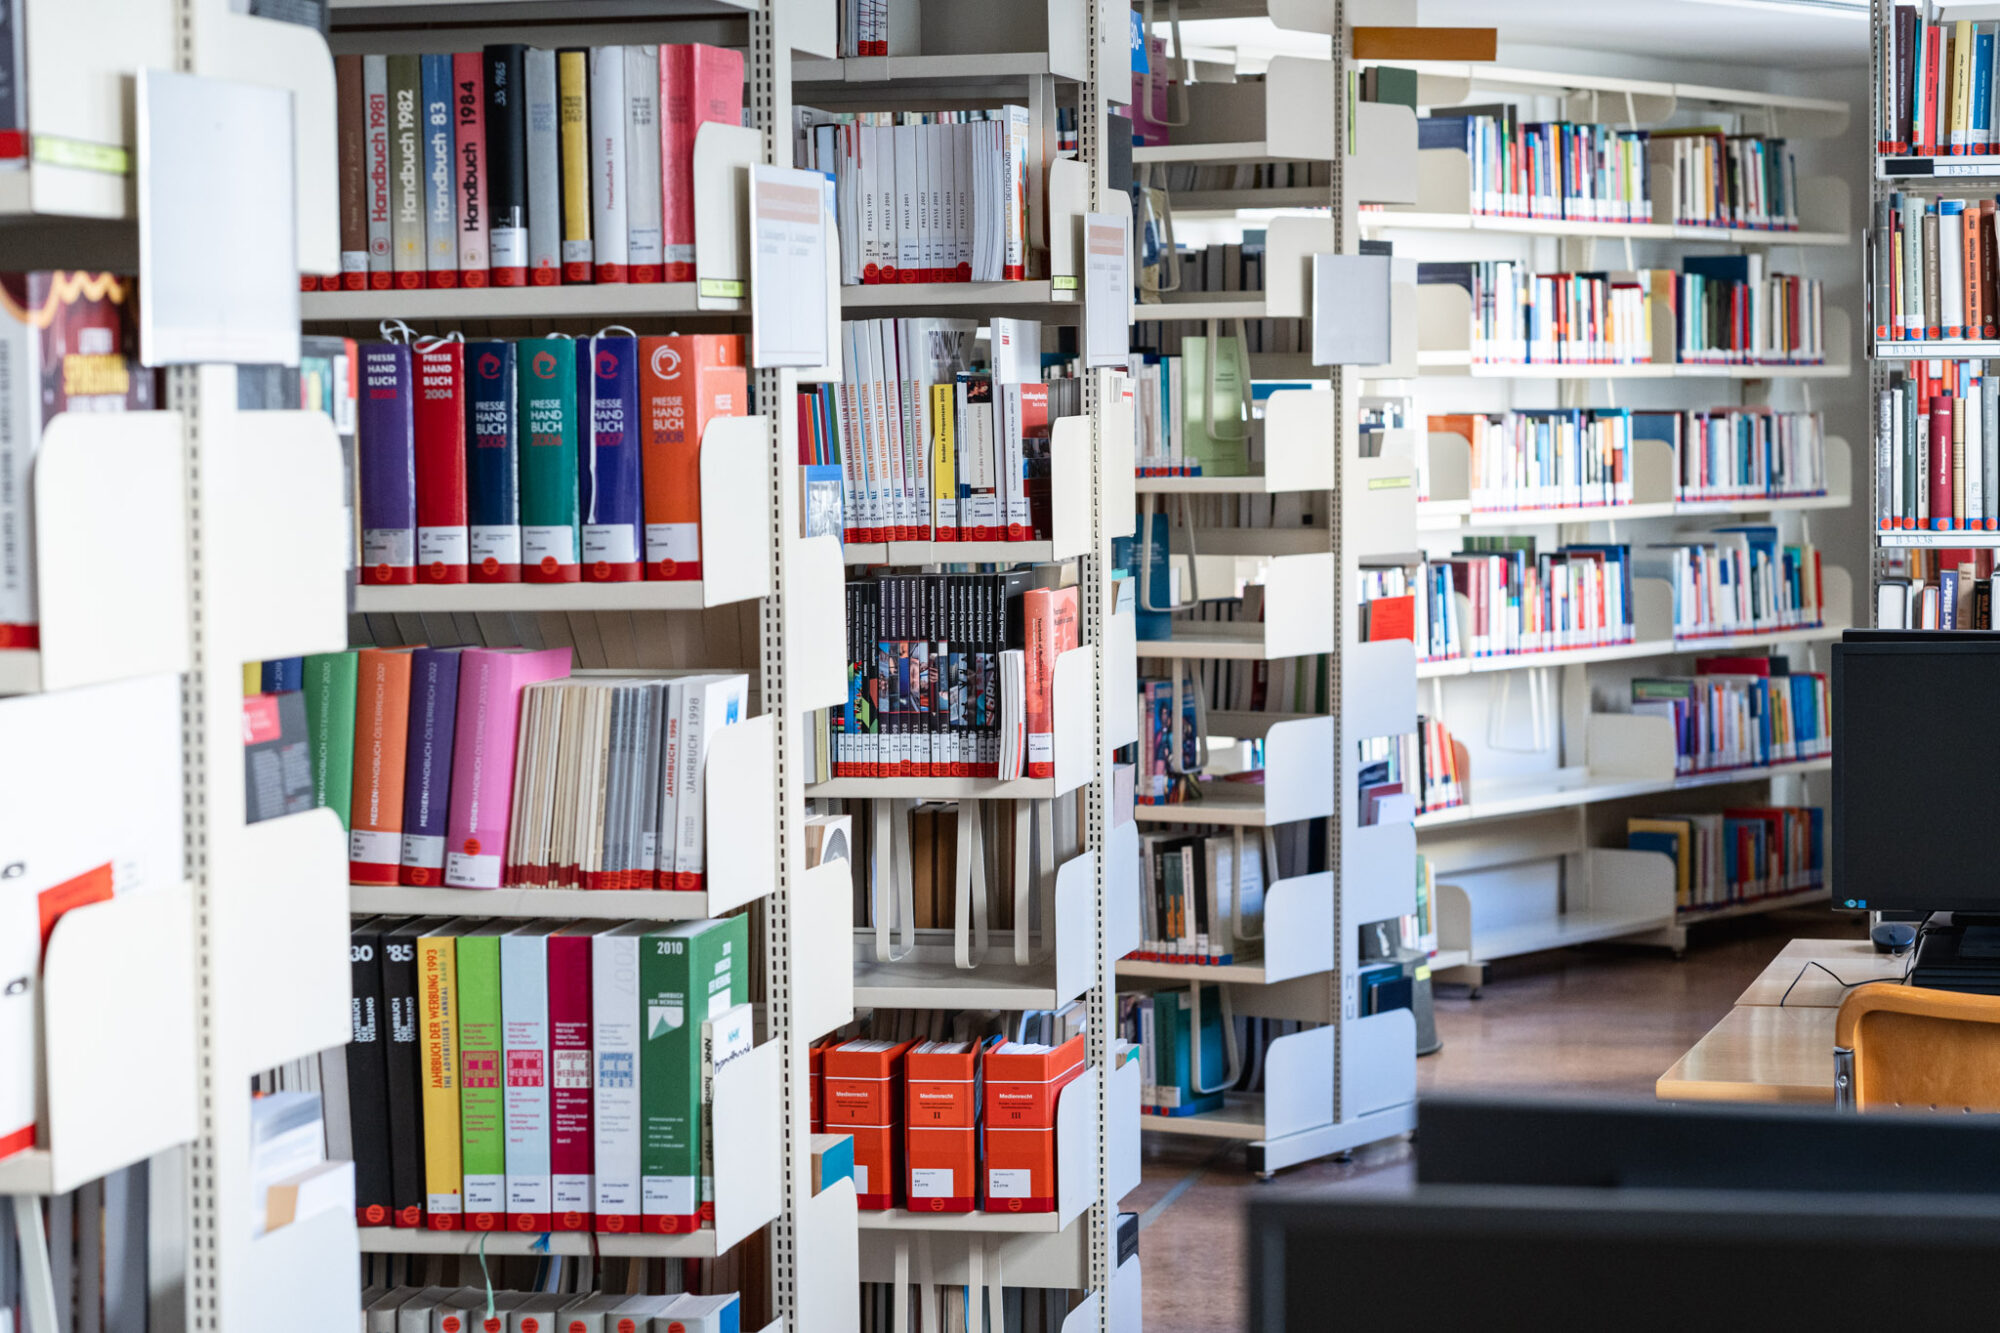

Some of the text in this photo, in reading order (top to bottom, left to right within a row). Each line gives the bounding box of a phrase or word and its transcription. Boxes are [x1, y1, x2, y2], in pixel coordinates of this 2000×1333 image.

[370, 94, 388, 222] Handbuch 1981
[397, 89, 417, 222] Handbuch 1982
[430, 102, 449, 222] Handbuch 83
[460, 81, 479, 232] Handbuch 1984
[367, 354, 396, 362] PRESSE
[423, 353, 452, 362] PRESSE
[367, 364, 396, 373] HAND
[423, 364, 452, 373] HAND
[368, 376, 397, 386] BUCH
[423, 376, 453, 386] BUCH
[425, 389, 453, 399] 2004
[876, 380, 884, 403] FESTIVAL
[476, 401, 507, 411] PRESSE
[530, 399, 561, 409] PRESSE
[652, 396, 683, 407] PRESSE
[476, 412, 507, 422] HAND
[531, 410, 562, 421] HAND
[652, 408, 684, 418] HAND
[476, 423, 507, 435] BUCH
[531, 422, 562, 433] BUCH
[652, 418, 684, 430] BUCH
[879, 419, 887, 459] INTERNATIONAL
[1943, 578, 1953, 613] Bilder
[322, 661, 331, 683] 2020
[420, 742, 432, 828] MEDIENHANDBUCH
[428, 662, 437, 683] 2022
[685, 697, 700, 794] JAHRBUCH 1998
[666, 743, 676, 798] JAHRBUCH
[370, 740, 381, 826] MEDIENHANDBUCH
[470, 757, 483, 833] MEDIENHANDBUCH
[386, 944, 414, 962] '85
[657, 941, 684, 955] 2010
[441, 987, 449, 1016] ANNUAL
[352, 998, 362, 1041] JAHRBUCH
[366, 997, 376, 1041] WERBUNG
[392, 997, 402, 1041] JAHRBUCH
[426, 949, 443, 1088] JAHRBUCH DER WERBUNG 1993
[442, 1020, 451, 1072] ADVERTISER'S
[704, 1038, 712, 1065] NHK
[443, 1075, 452, 1088] THE
[836, 1090, 868, 1098] Medienrecht
[920, 1092, 954, 1100] Medienrecht
[999, 1092, 1033, 1100] Medienrecht
[933, 1111, 941, 1120] II
[1011, 1111, 1021, 1120] III
